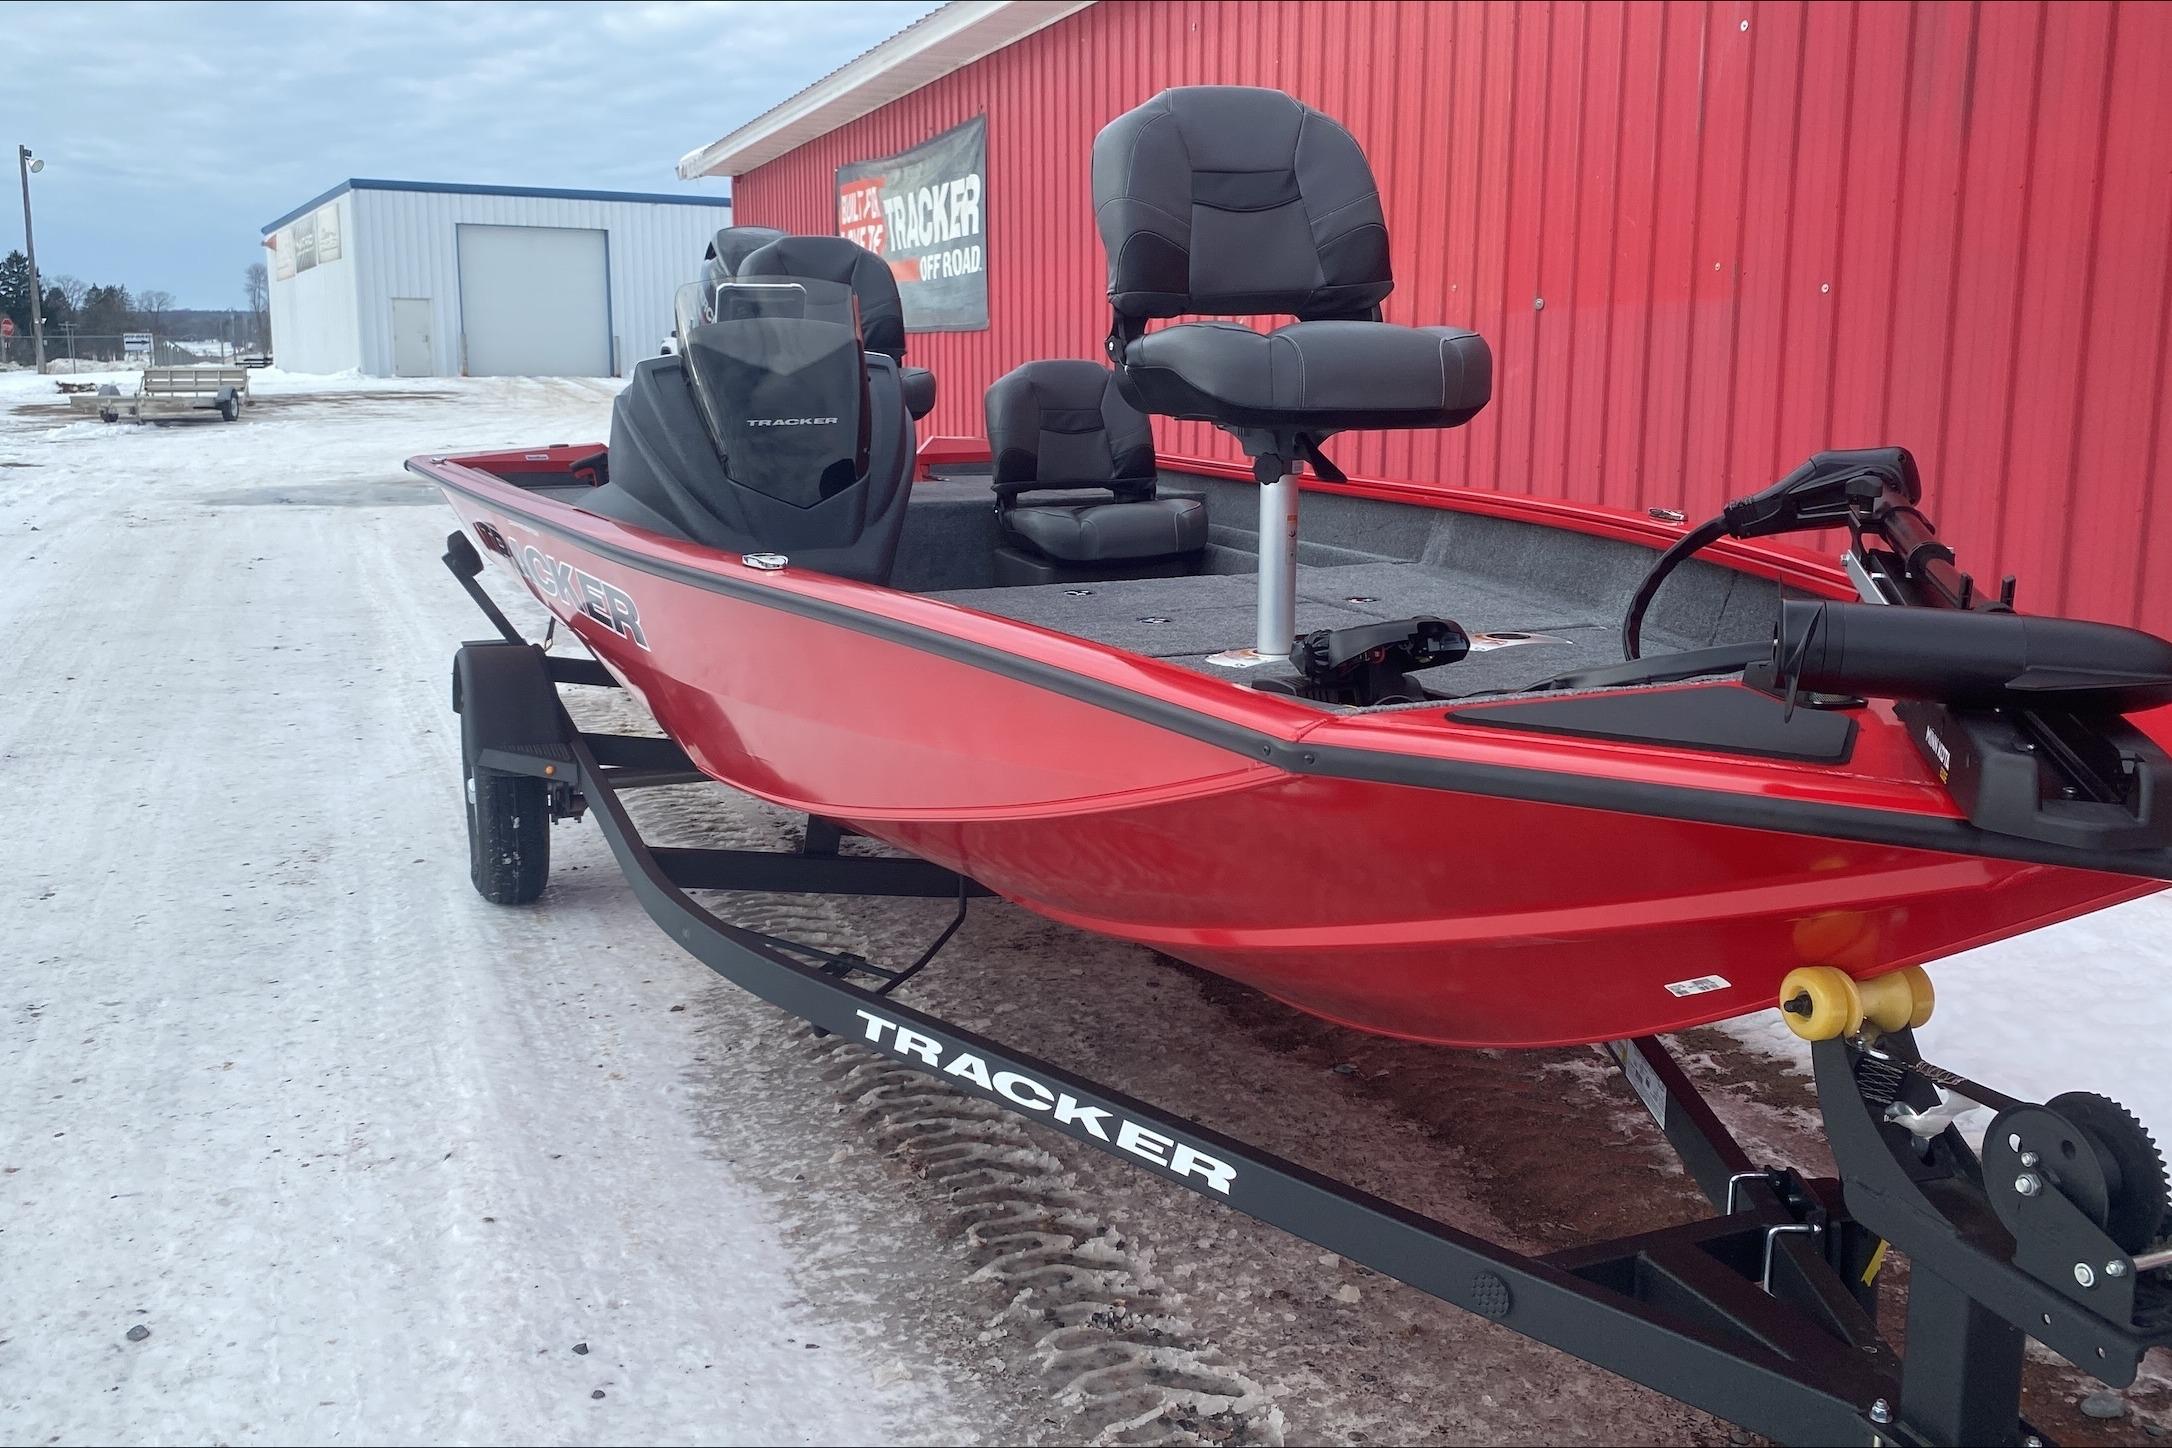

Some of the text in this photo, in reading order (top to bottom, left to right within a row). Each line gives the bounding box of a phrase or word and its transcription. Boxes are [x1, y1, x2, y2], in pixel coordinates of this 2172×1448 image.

[883, 173, 981, 252] TRACKER
[919, 251, 941, 282] OFF
[746, 417, 838, 427] TRACKER
[856, 1008, 1238, 1196] TRACKER
